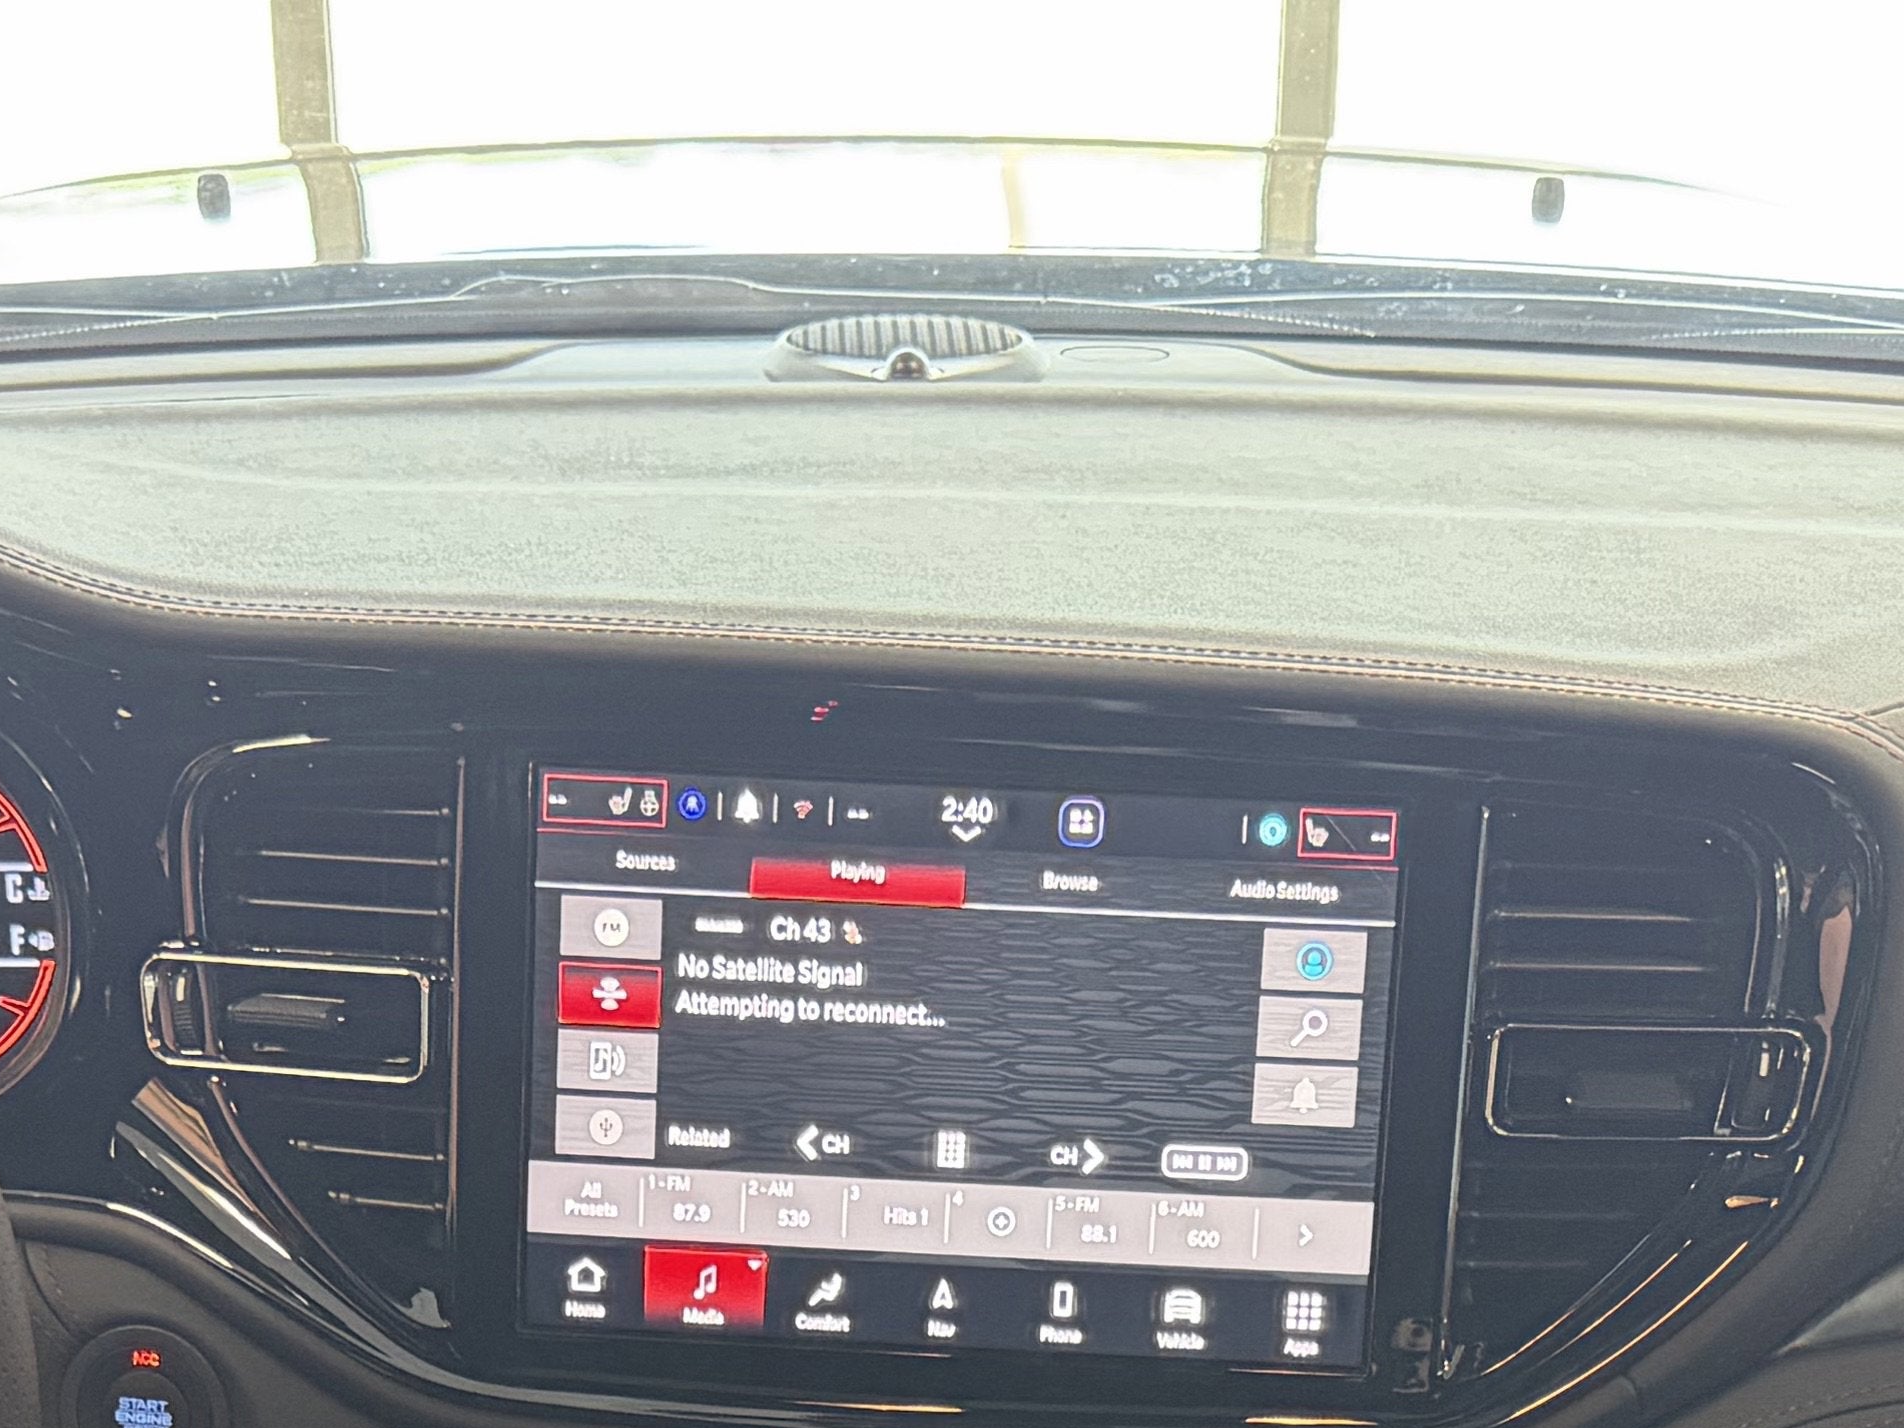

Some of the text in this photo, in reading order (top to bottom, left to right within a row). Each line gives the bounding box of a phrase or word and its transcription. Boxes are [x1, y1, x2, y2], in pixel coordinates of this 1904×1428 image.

[941, 795, 994, 825] 2:40
[615, 849, 677, 872] Sources
[831, 860, 886, 885] Playing
[1042, 871, 1099, 893] Browse
[5, 873, 24, 904] C
[1230, 879, 1340, 905] Audio Settings
[9, 923, 26, 955] F
[769, 915, 800, 942] Ch
[803, 917, 832, 943] 43
[678, 951, 864, 990] No Satellite Signal
[674, 988, 946, 1027] Attempting to reconnect...
[668, 1124, 731, 1149] Related
[822, 1134, 851, 1156] CH
[1050, 1145, 1079, 1167] CH
[581, 1181, 602, 1199] All
[564, 1199, 619, 1218] Presets
[672, 1202, 712, 1224] 87.9
[777, 1207, 811, 1228] 530
[883, 1205, 918, 1227] Hits
[1080, 1223, 1118, 1245] 88.1
[1186, 1229, 1221, 1249] 600
[564, 1301, 606, 1320] Home
[682, 1306, 725, 1326] Media
[795, 1312, 851, 1333] Comfort
[927, 1319, 957, 1339] Nav
[1039, 1323, 1084, 1346] Phone
[1156, 1330, 1206, 1352] Vehicle
[1283, 1337, 1320, 1359] Apps
[118, 1396, 169, 1412] START
[114, 1411, 173, 1426] ENGINE
